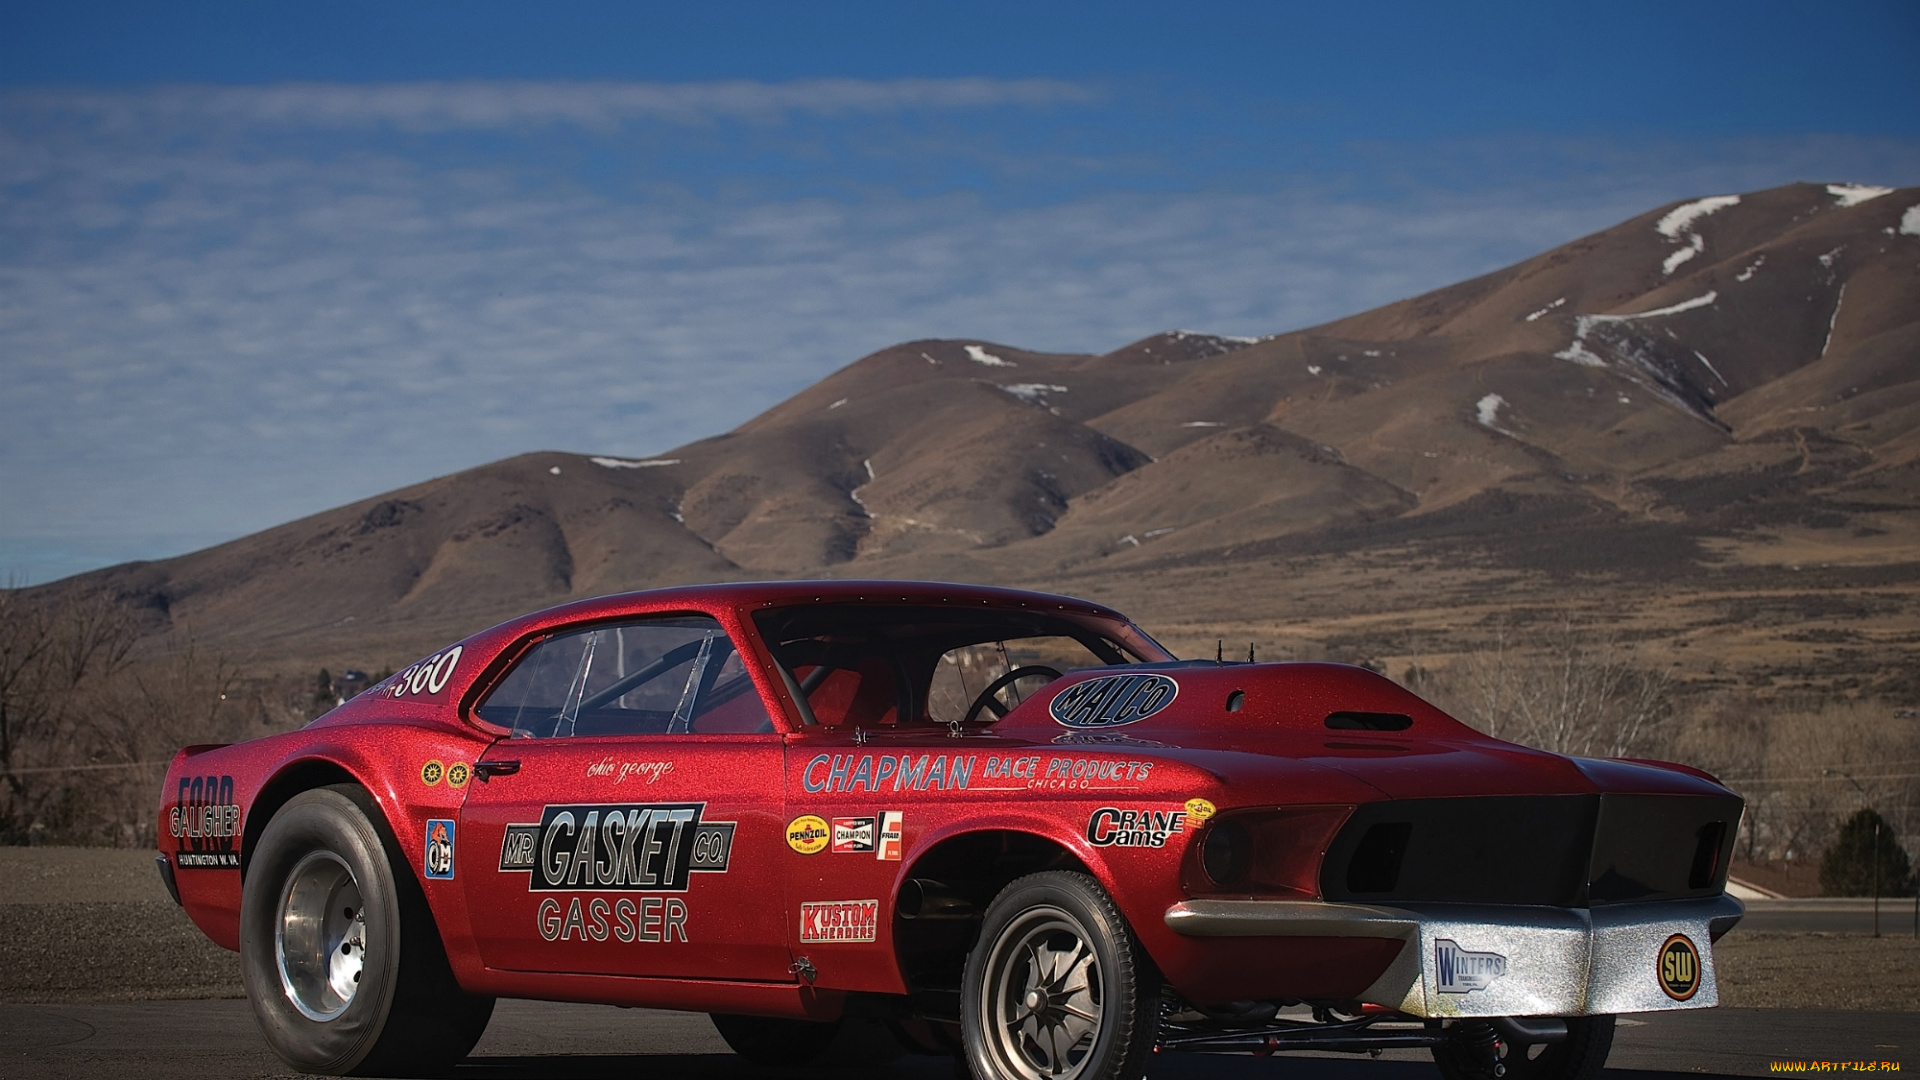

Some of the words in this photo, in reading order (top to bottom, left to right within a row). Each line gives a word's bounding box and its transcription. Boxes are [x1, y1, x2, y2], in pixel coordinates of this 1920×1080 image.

[395, 645, 463, 698] 360
[1055, 676, 1170, 725] MALCO
[613, 761, 674, 785] george
[802, 753, 977, 793] CHAPMAN
[983, 756, 1040, 779] RACE
[1045, 758, 1153, 781] PRODUCTS
[1027, 779, 1089, 789] CHICAGO
[169, 804, 241, 838] GALIGHER
[178, 775, 234, 852] FORD
[1087, 807, 1187, 846] CRANE
[504, 832, 535, 864] MR.
[541, 808, 695, 885] GASKET
[693, 831, 724, 863] CO.
[789, 829, 828, 841] PENNZOIL
[836, 830, 871, 840] CHAMPION
[179, 854, 218, 866] HUNTINGTON
[537, 897, 689, 942] GASSER
[802, 903, 876, 939] KUSTOM
[821, 927, 874, 939] HEADERS
[1438, 947, 1501, 986] WINTERS
[1664, 951, 1692, 982] SW
